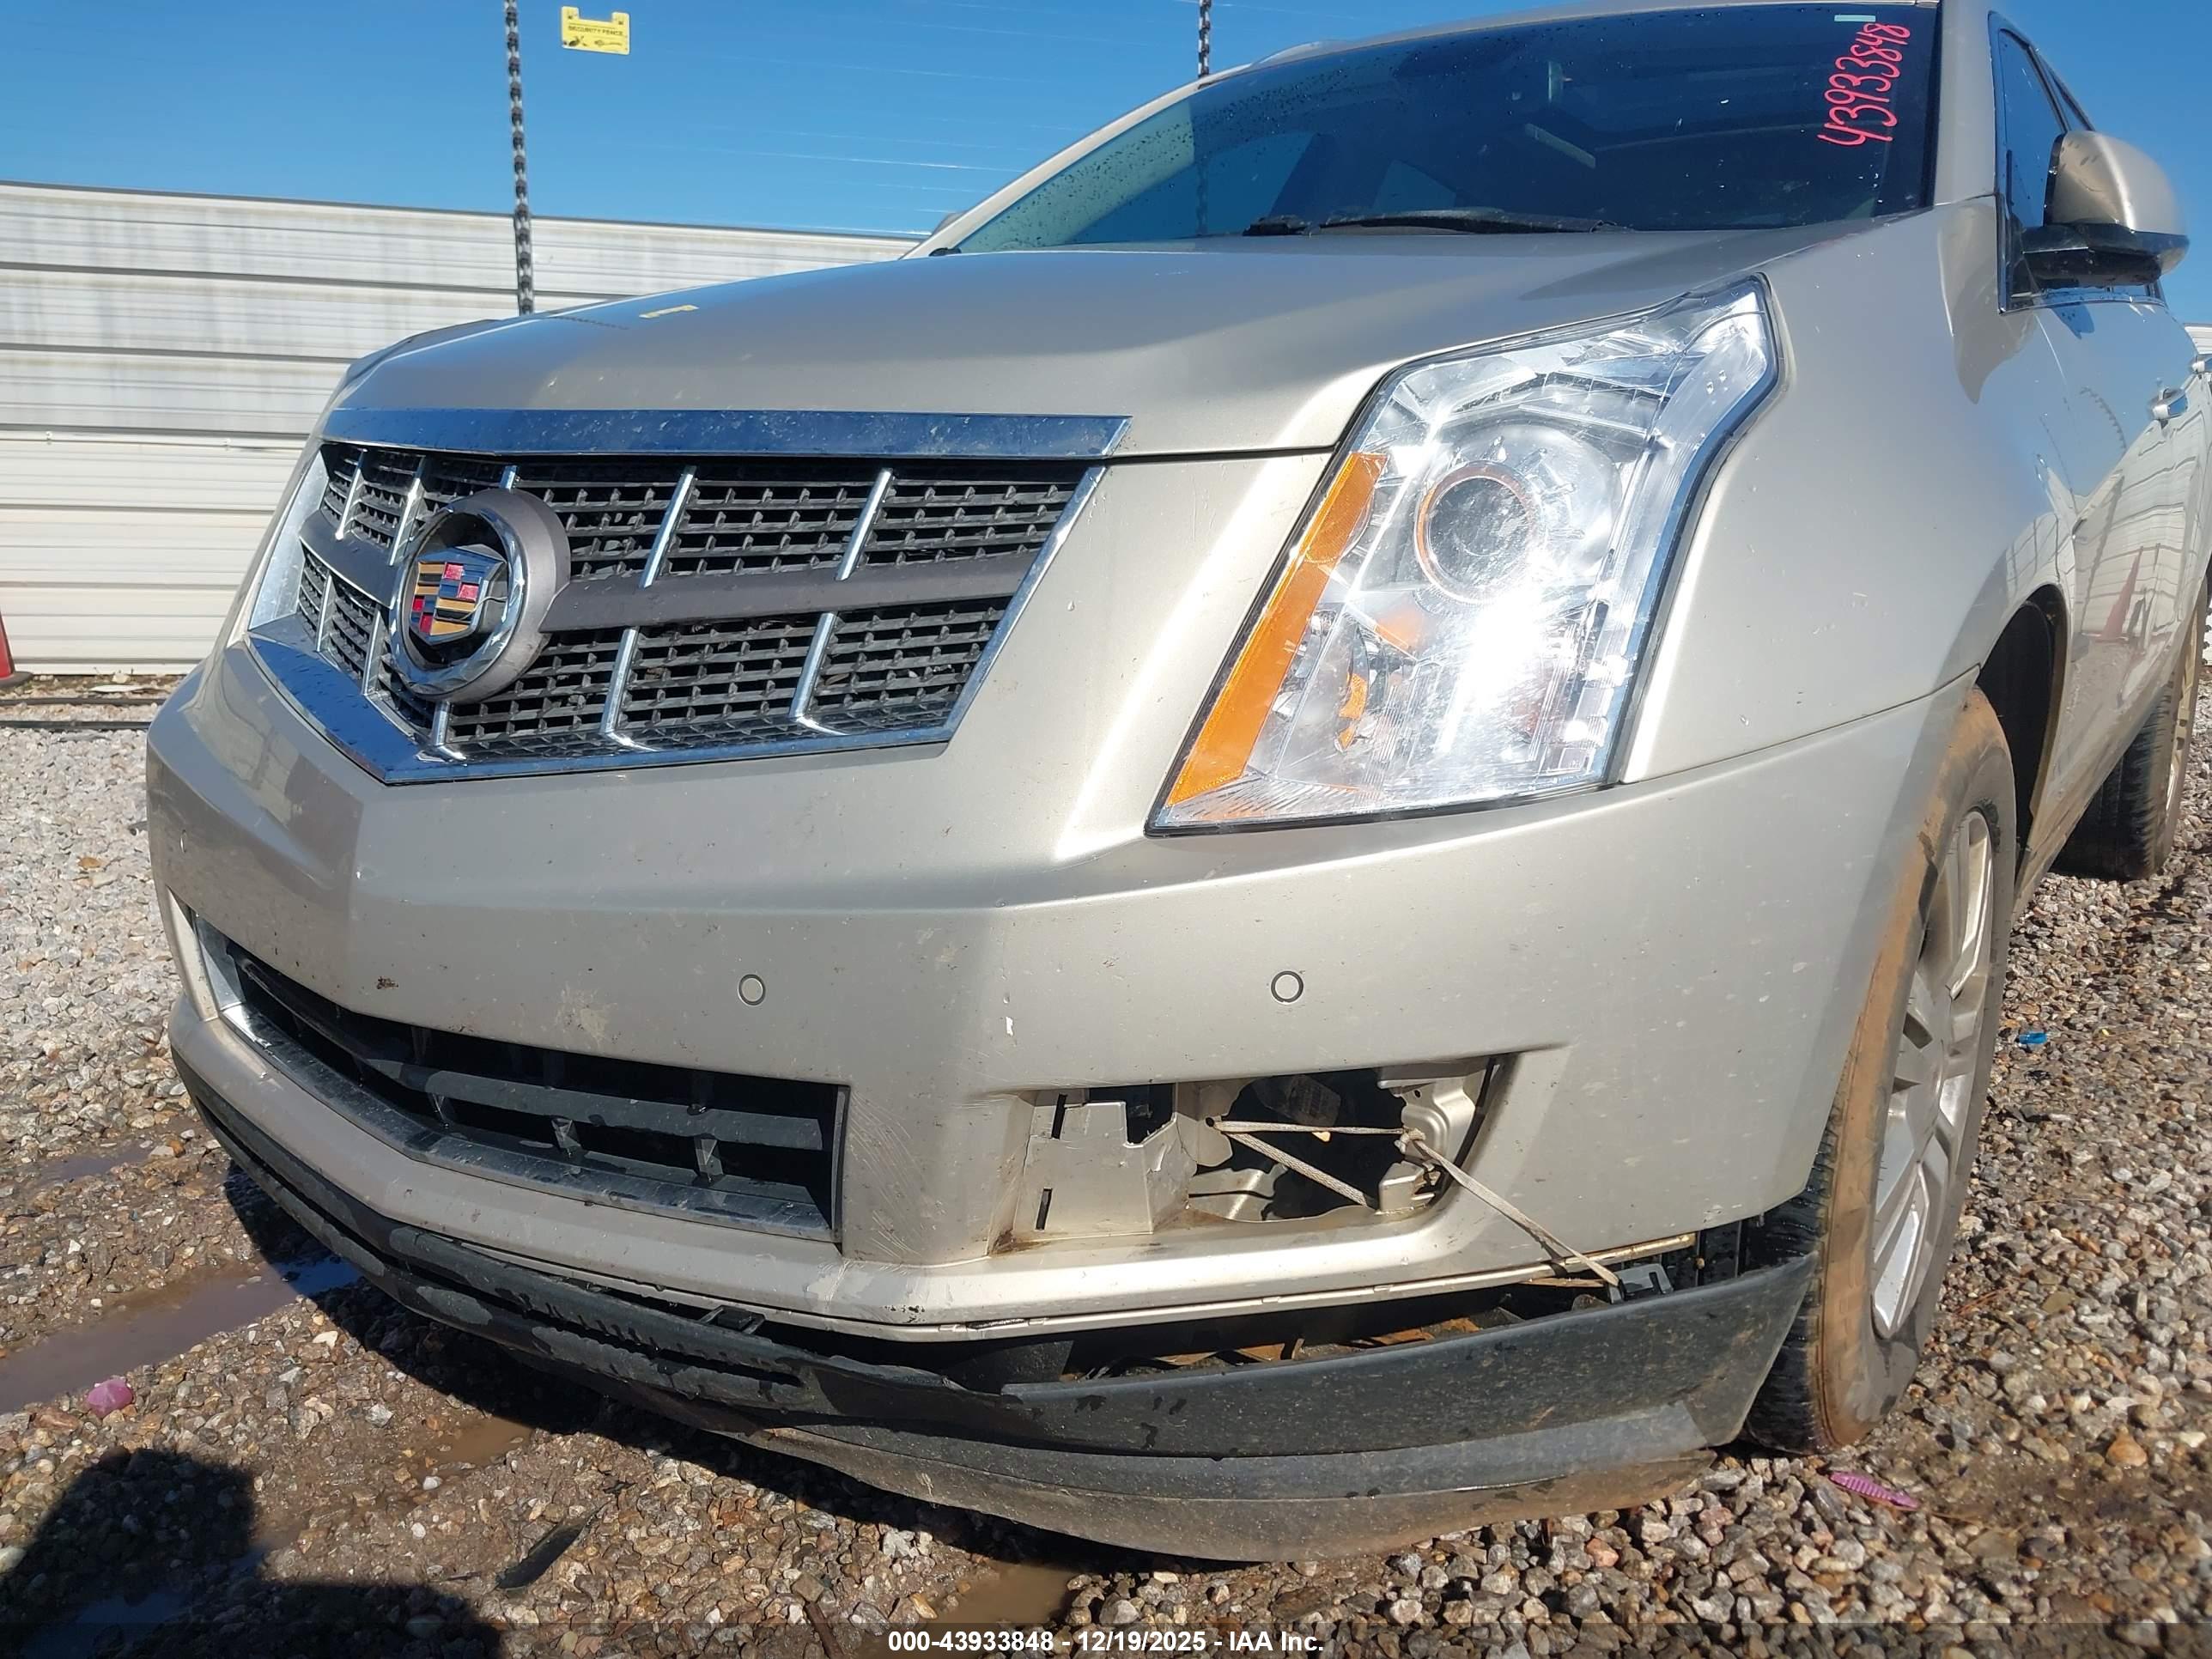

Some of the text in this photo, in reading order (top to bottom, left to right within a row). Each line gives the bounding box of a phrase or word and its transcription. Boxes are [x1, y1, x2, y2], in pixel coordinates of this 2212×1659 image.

[568, 25, 623, 37] SECURITY FENCE
[1817, 22, 1911, 146] 43933848
